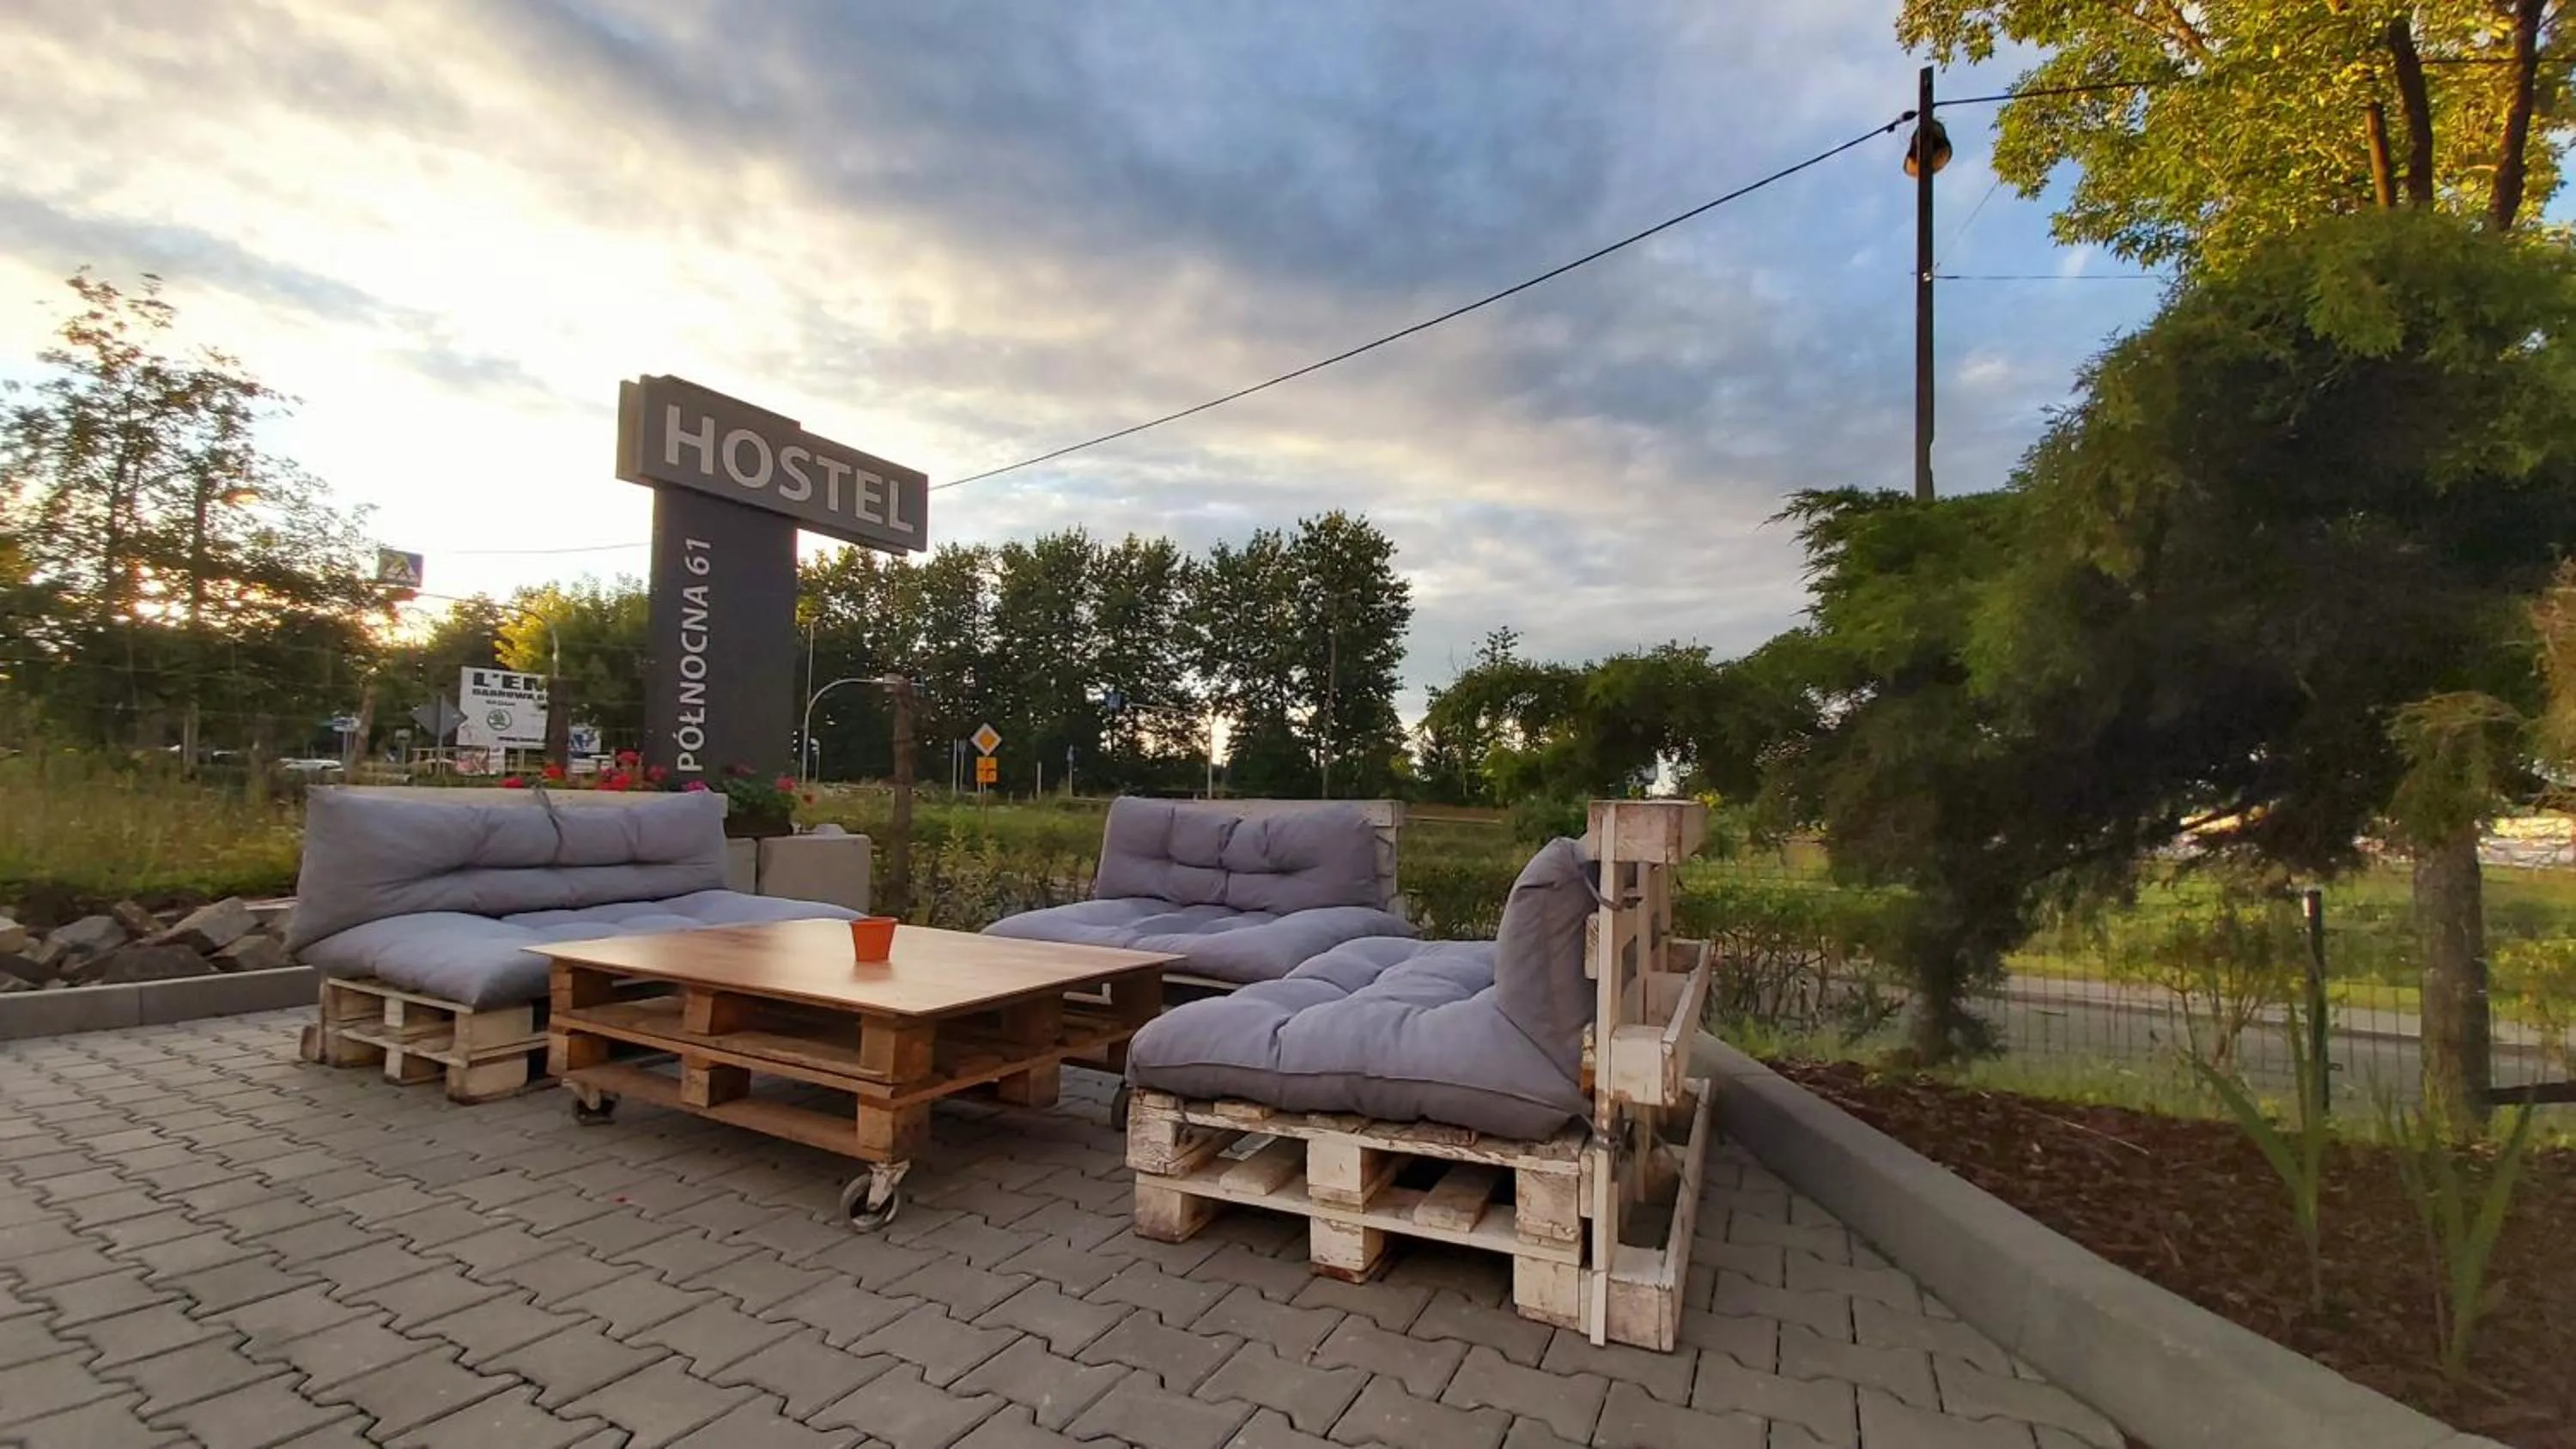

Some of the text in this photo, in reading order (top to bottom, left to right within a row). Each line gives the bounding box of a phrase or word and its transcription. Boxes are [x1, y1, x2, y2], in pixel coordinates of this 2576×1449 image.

[664, 403, 914, 534] HOSTEL
[672, 537, 712, 772] PÓŁNOCNA 61
